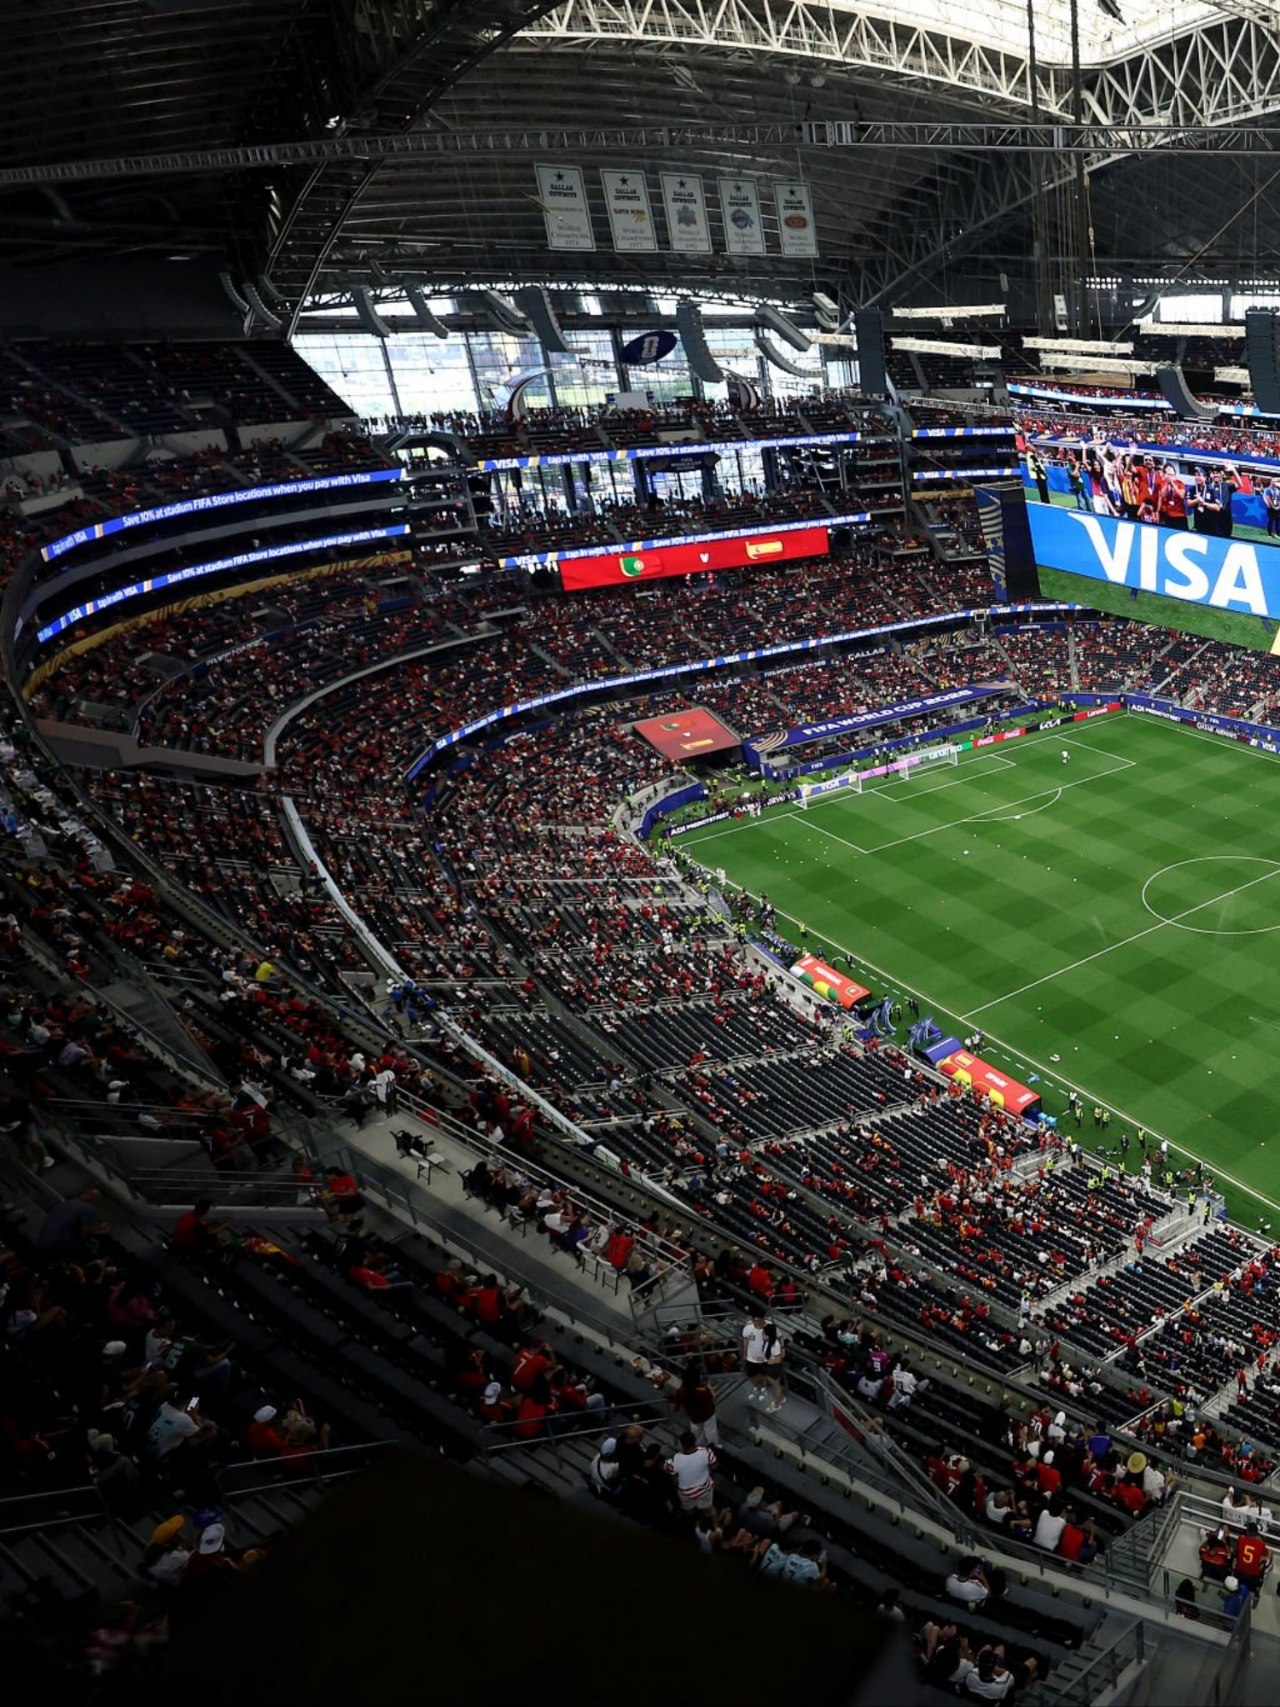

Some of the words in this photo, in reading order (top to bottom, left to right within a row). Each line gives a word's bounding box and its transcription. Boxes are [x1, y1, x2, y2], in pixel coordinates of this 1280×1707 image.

[493, 459, 520, 469] VISA
[122, 516, 139, 527] Save
[140, 511, 156, 523] 10%
[194, 498, 212, 510] FIFA
[212, 496, 235, 506] Store
[235, 489, 272, 502] locations
[273, 485, 297, 495] when
[298, 482, 314, 493] you
[315, 480, 330, 490] pay
[330, 476, 351, 487] with
[352, 473, 371, 484] Visa
[1067, 512, 1268, 616] VISA
[802, 720, 842, 736] FIFA
[843, 707, 893, 728] WORLD
[894, 701, 926, 715] CUP
[927, 688, 973, 706] 2026
[1261, 741, 1278, 753] VISA
[1243, 1545, 1256, 1564] 5
